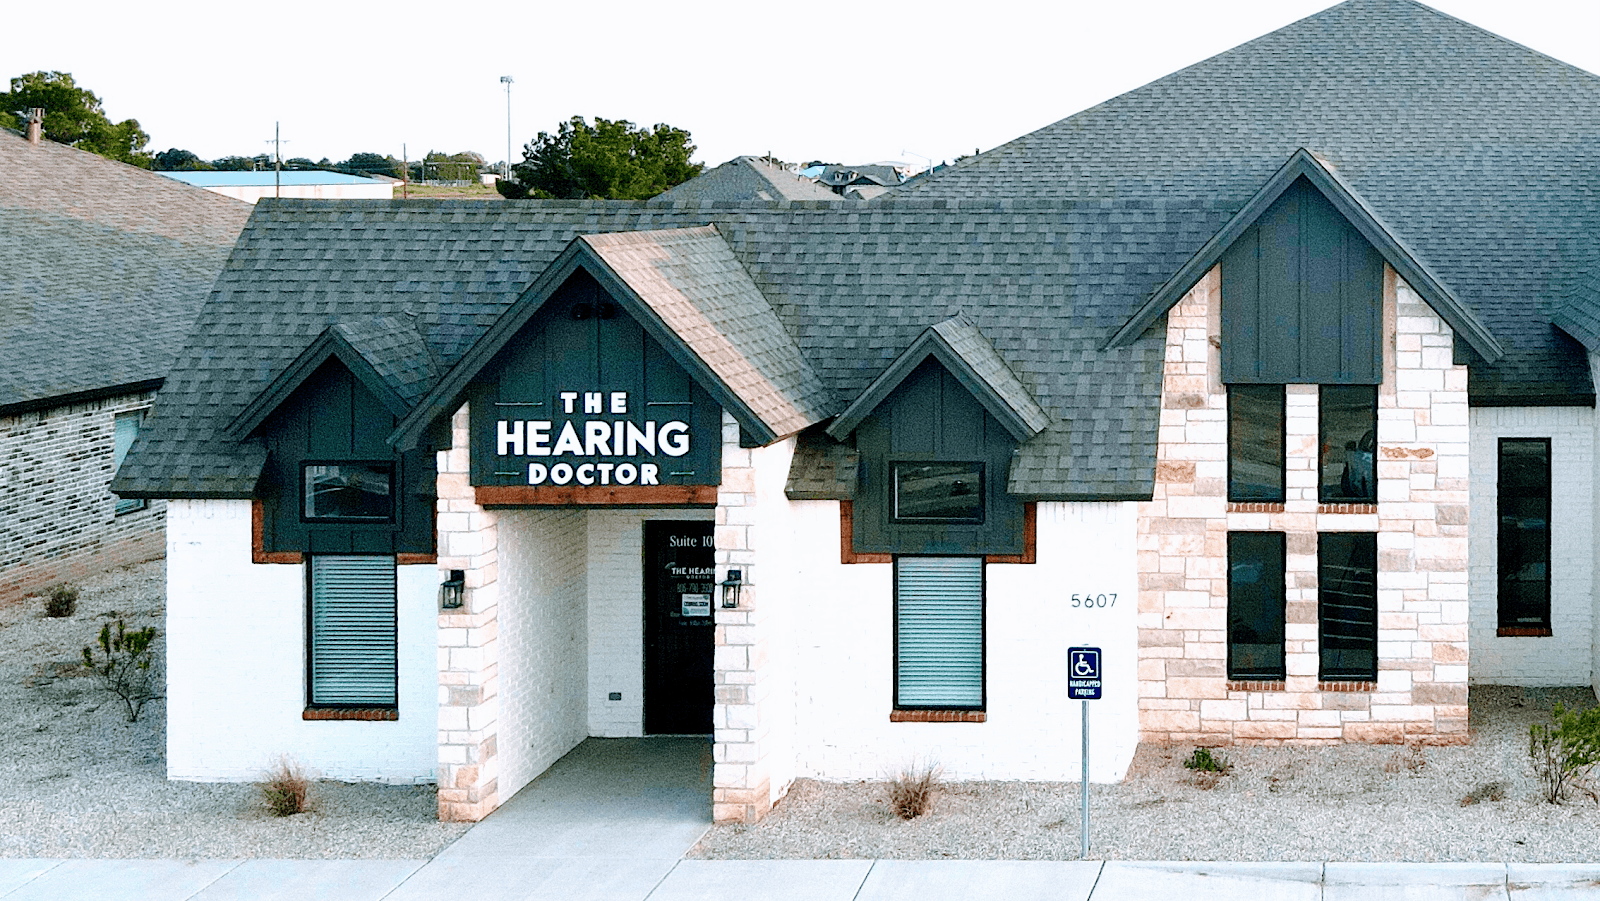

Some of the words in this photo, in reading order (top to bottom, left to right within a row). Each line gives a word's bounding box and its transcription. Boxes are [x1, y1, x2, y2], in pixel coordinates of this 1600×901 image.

[560, 392, 627, 414] THE
[497, 420, 690, 456] HEARING
[528, 463, 659, 485] DOCTOR
[670, 535, 697, 547] Suite
[703, 535, 715, 547] 10
[671, 567, 687, 575] THE
[1071, 593, 1118, 608] 5607
[1075, 688, 1096, 696] PARKING
